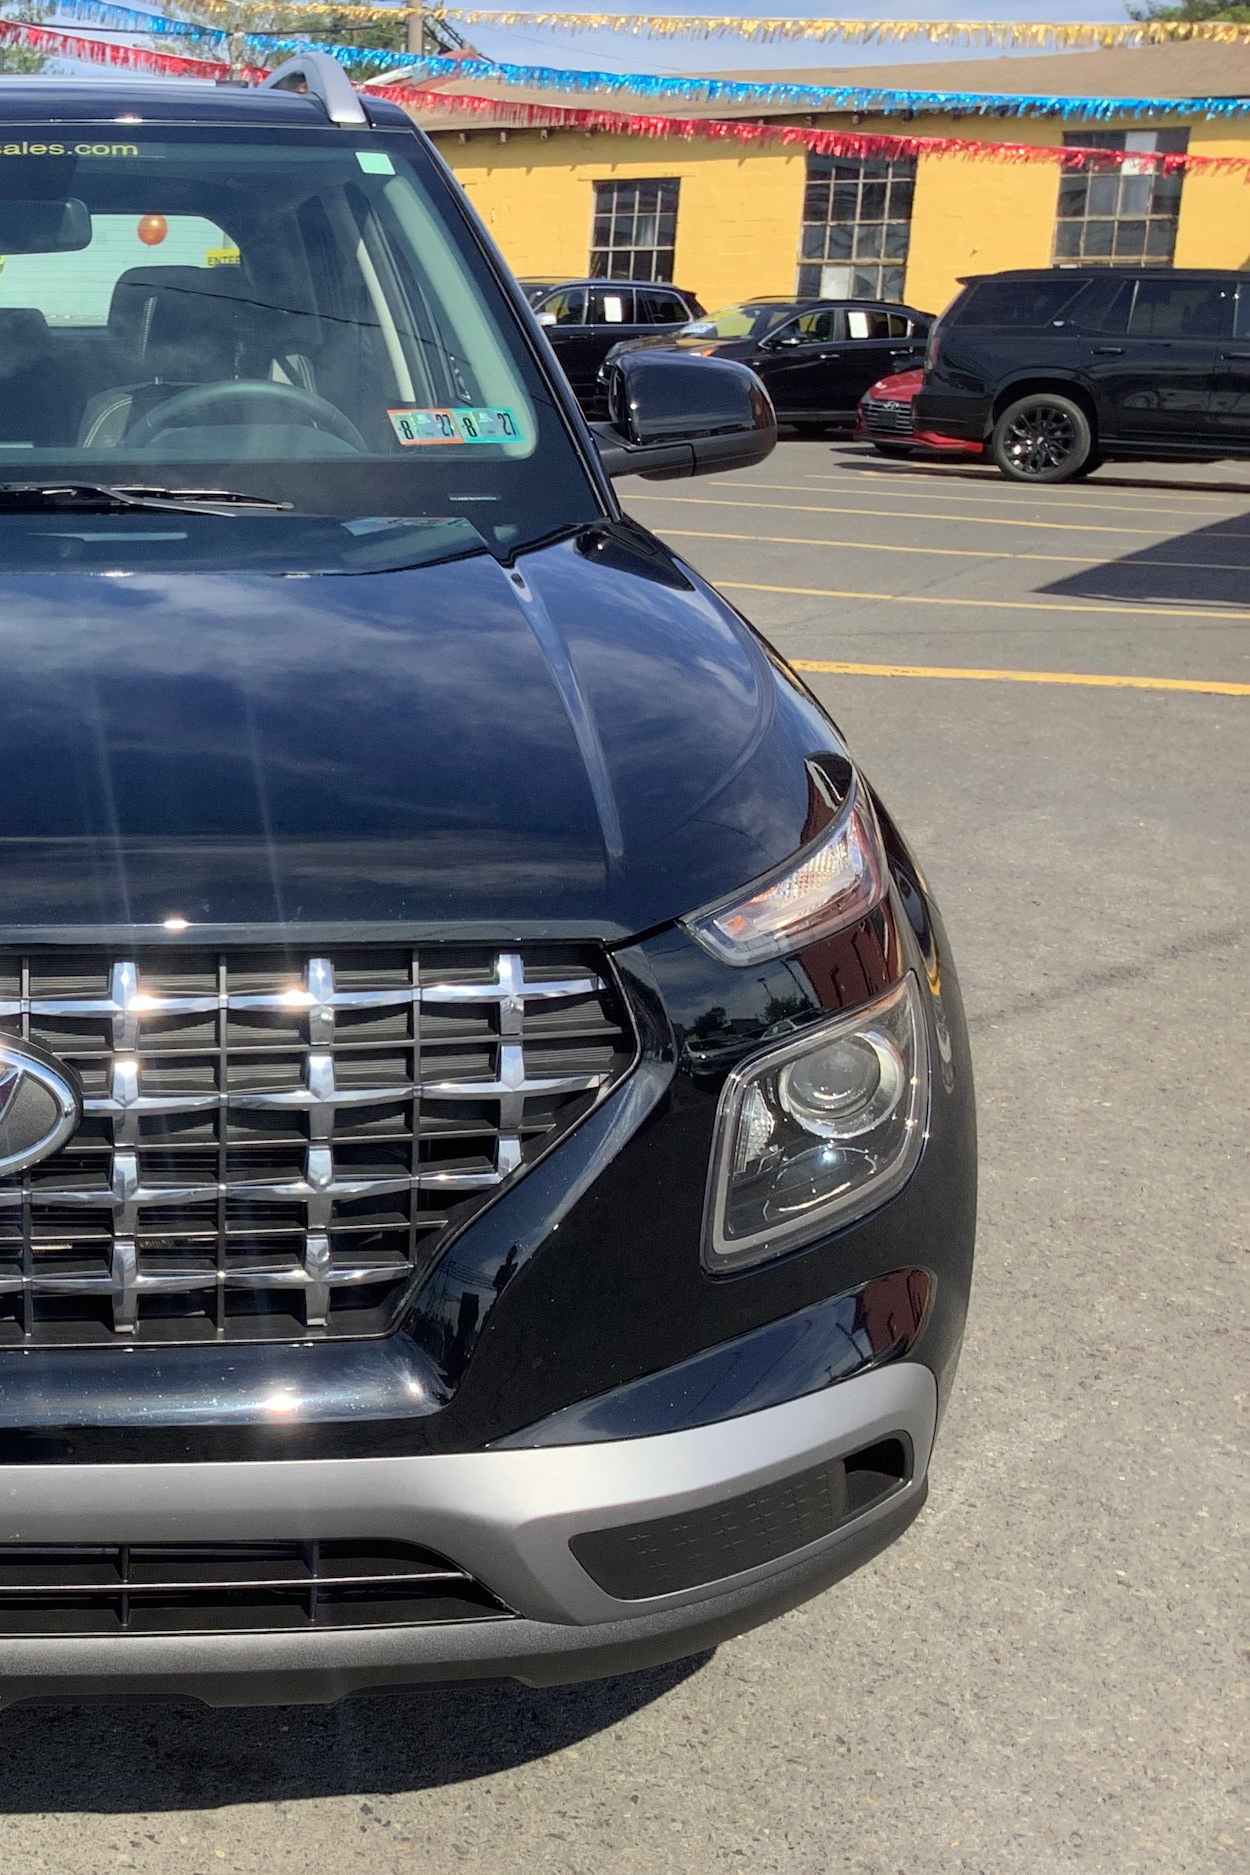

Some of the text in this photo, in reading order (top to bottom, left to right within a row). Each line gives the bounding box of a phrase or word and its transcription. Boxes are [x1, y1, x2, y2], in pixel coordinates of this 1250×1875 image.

[400, 414, 454, 440] 8 27
[462, 413, 517, 437] 8 27
